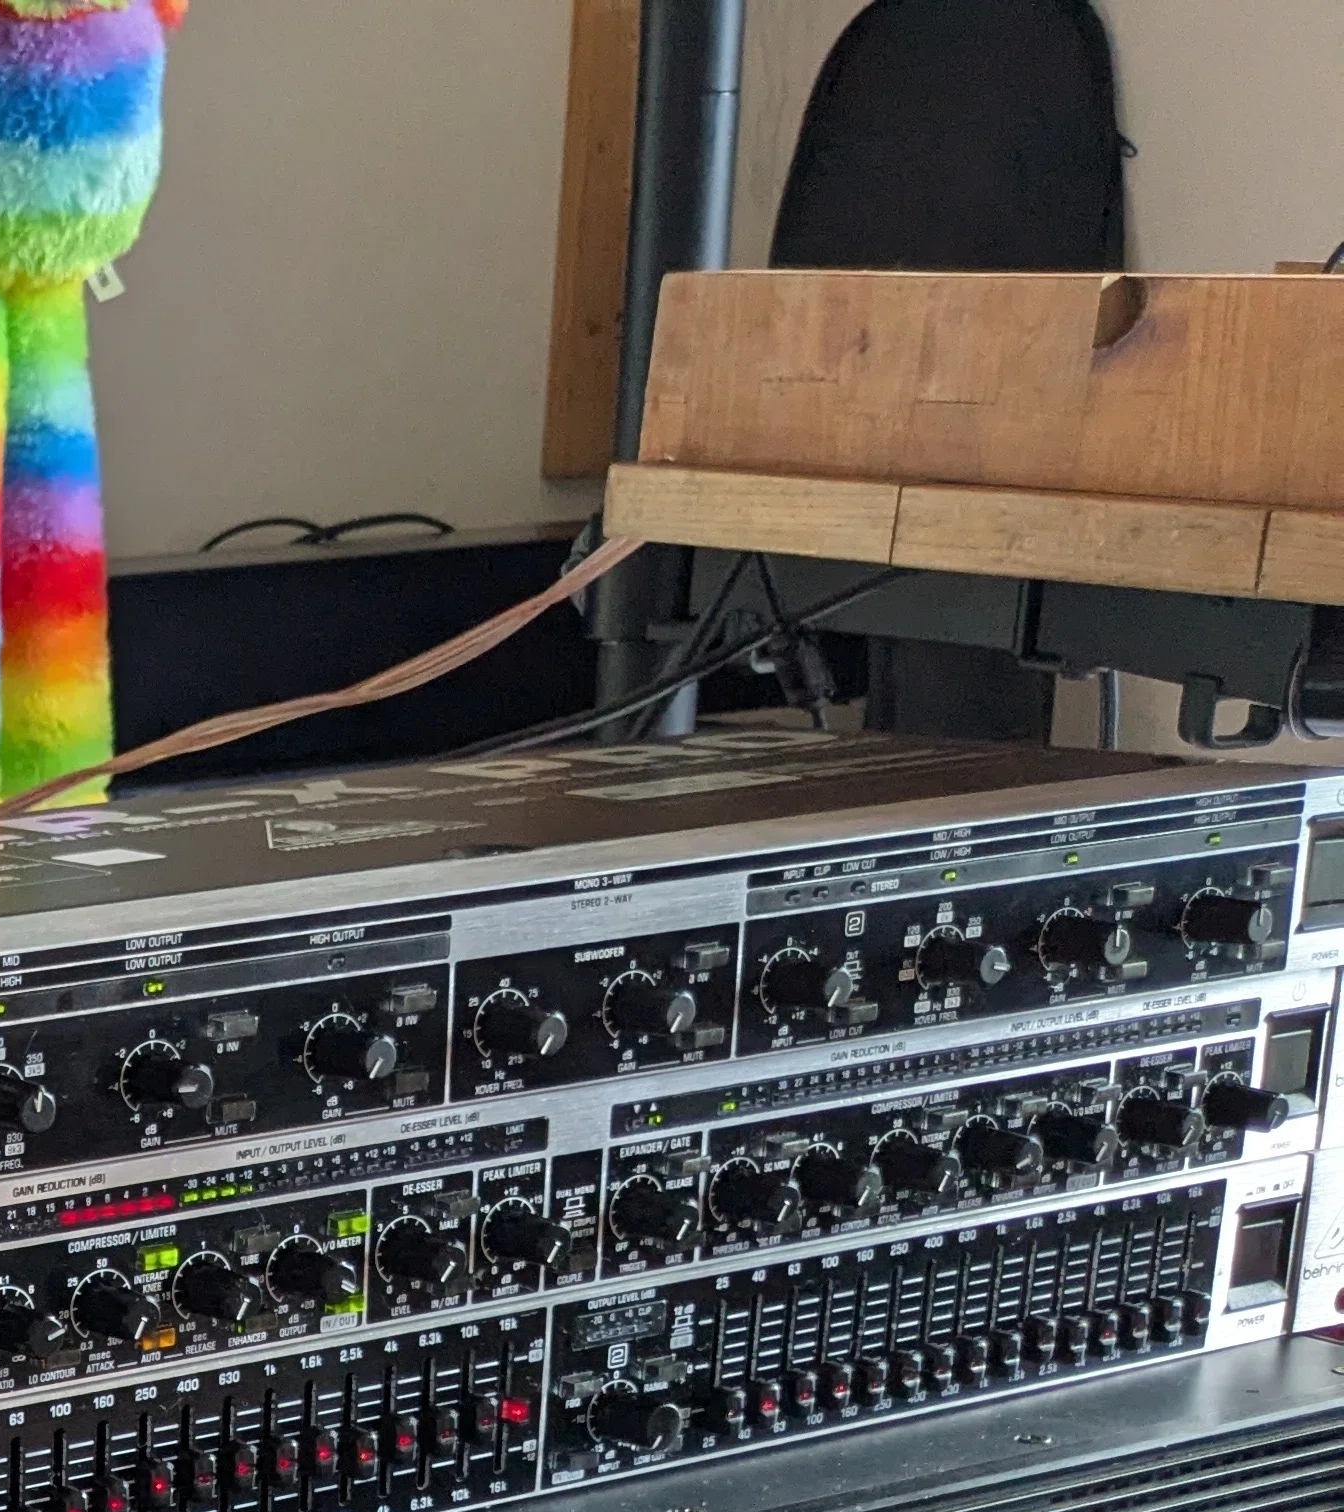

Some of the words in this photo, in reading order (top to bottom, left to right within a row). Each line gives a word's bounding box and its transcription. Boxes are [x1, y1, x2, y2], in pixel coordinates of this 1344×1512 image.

[215, 1124, 238, 1136] MUTE
[483, 1168, 505, 1181] PEAK
[507, 1162, 541, 1178] LIMITER
[12, 1184, 34, 1198] GAIN
[36, 1176, 86, 1194] REDUCTION
[68, 1235, 132, 1253] COMPRESSOR
[141, 1225, 177, 1241] LIMITER
[9, 1412, 24, 1426] 63
[50, 1403, 72, 1418] 100
[93, 1395, 115, 1410] 160
[135, 1386, 157, 1401] 250
[177, 1378, 199, 1393] 400
[219, 1371, 240, 1385] 630
[264, 1364, 277, 1377] 1k
[300, 1355, 322, 1369] 1.6k
[340, 1348, 363, 1363] 2.5k
